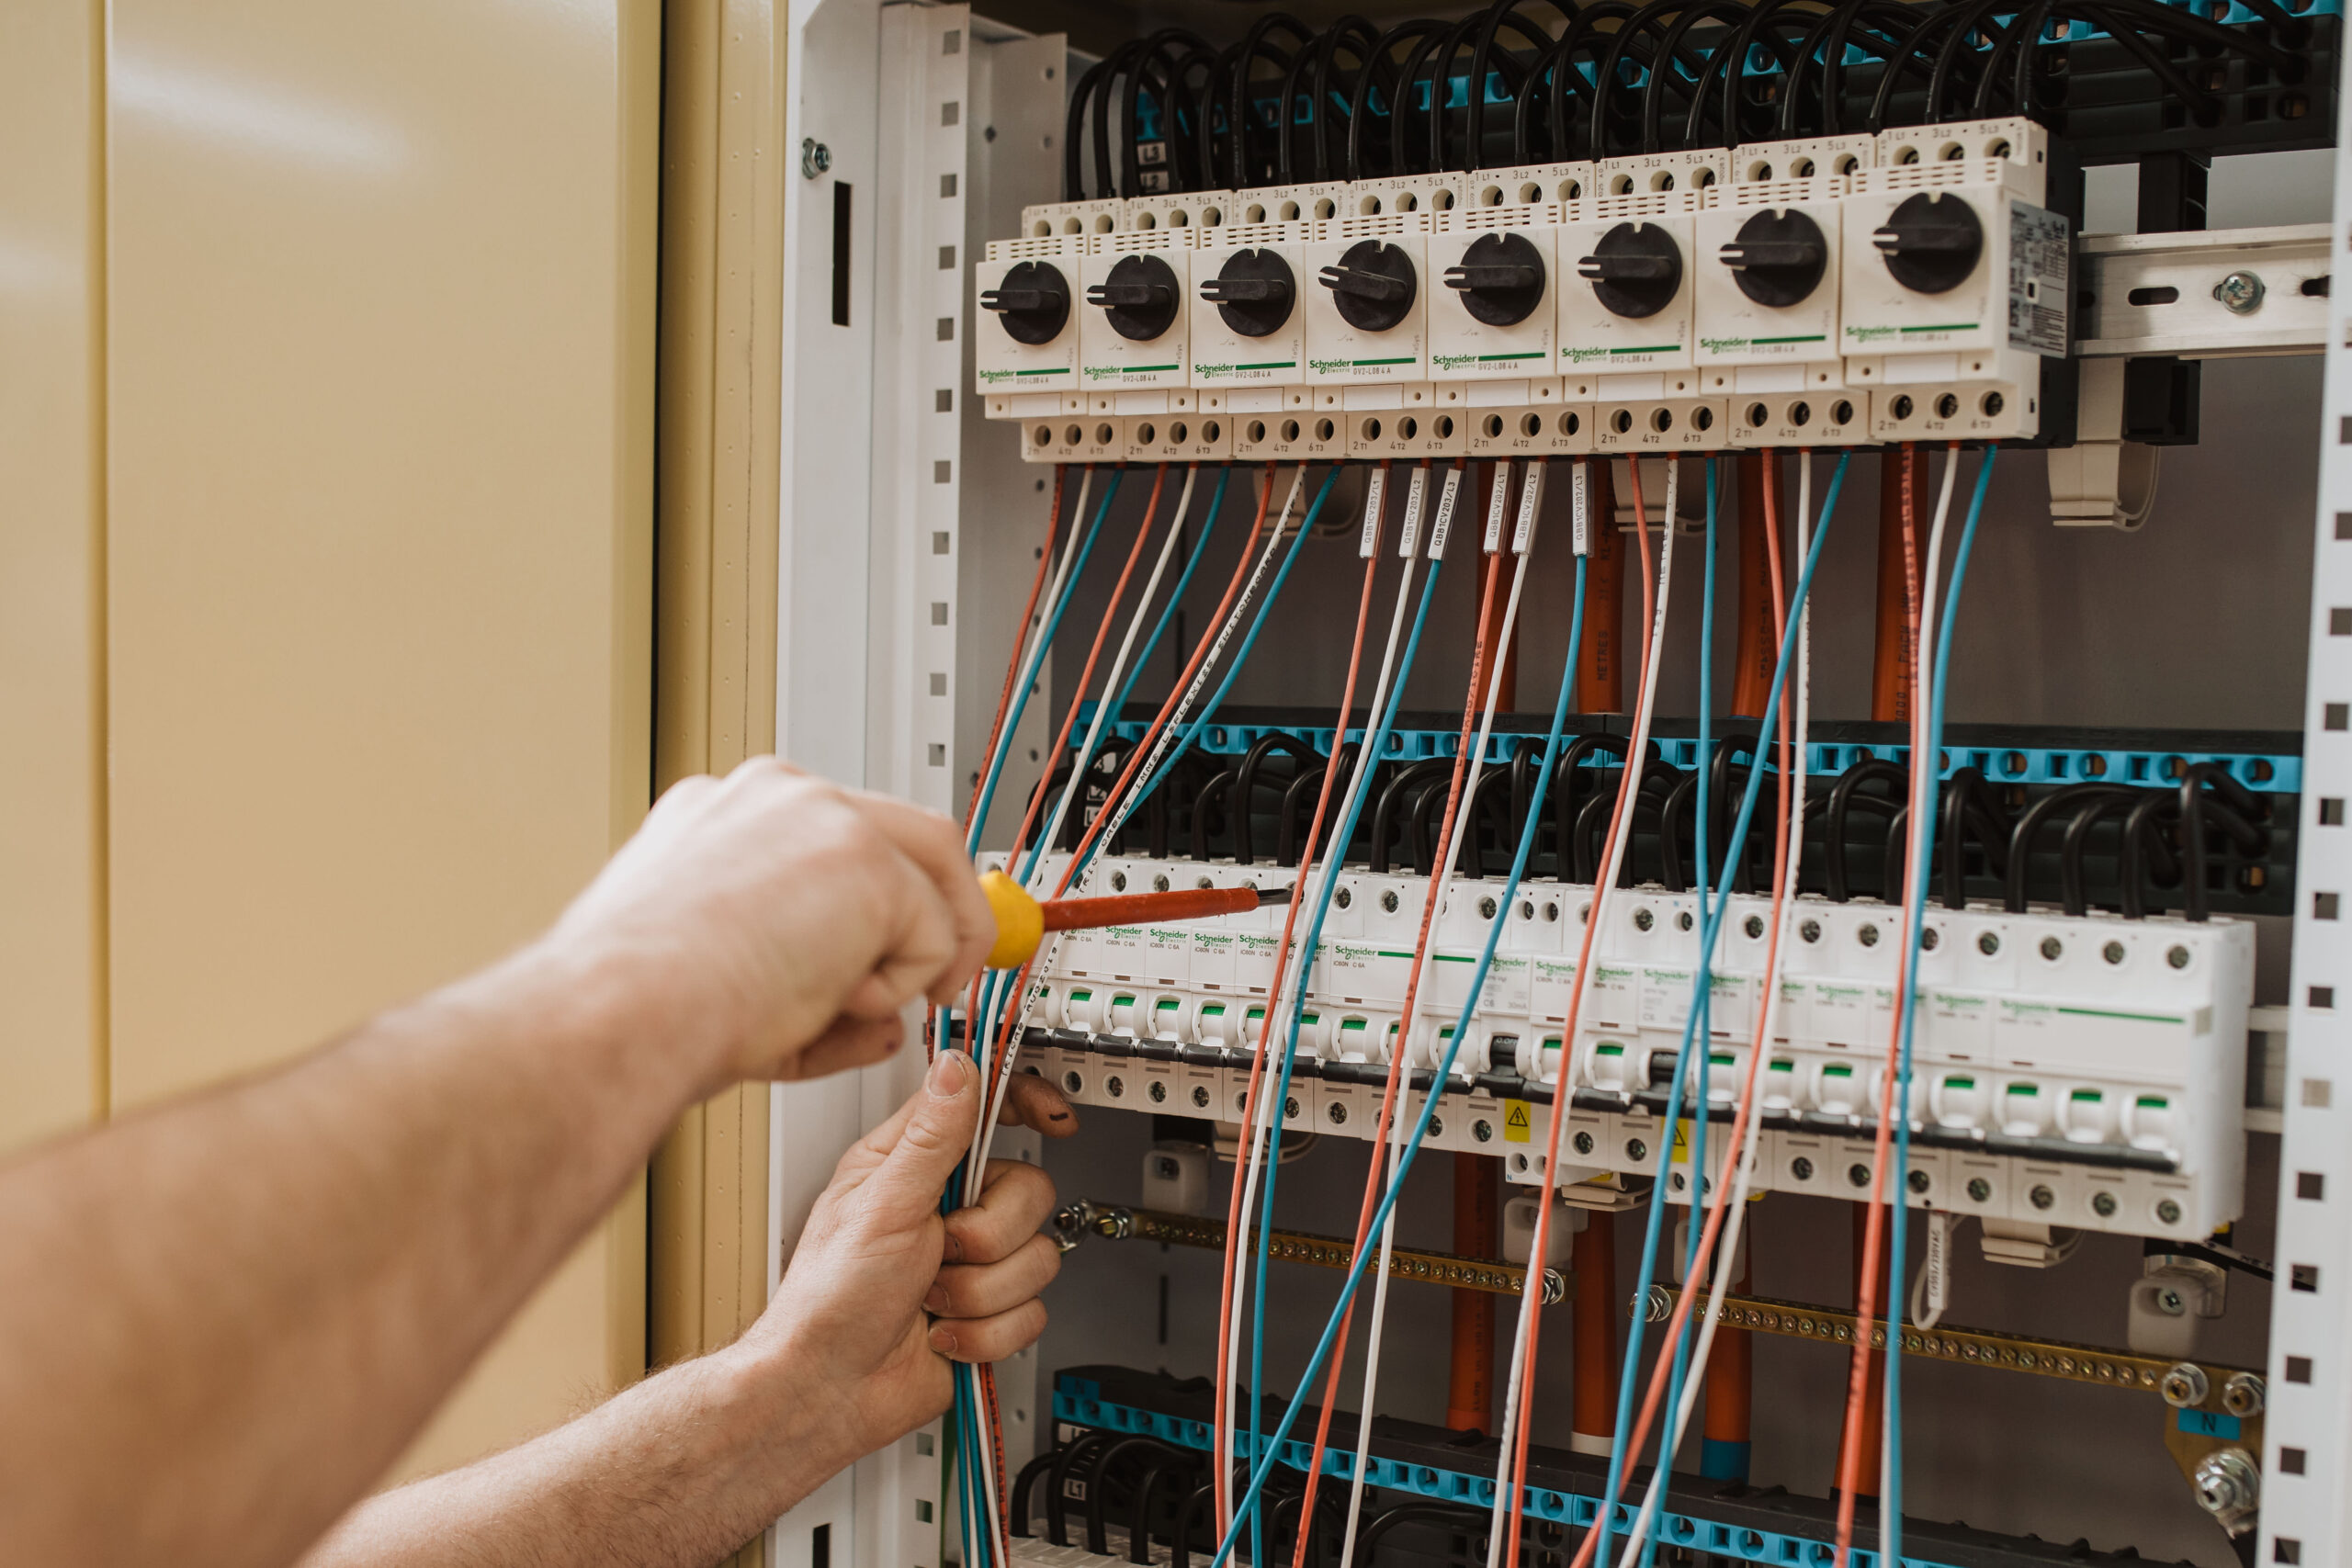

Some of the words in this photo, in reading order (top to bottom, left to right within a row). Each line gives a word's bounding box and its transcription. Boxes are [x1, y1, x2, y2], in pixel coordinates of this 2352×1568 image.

[1701, 336, 1749, 352] Schneider
[1562, 346, 1608, 361] Schneider
[1309, 358, 1351, 373] Schneider
[1432, 354, 1477, 368] Schneider
[979, 368, 1015, 381] Schneider
[1084, 366, 1122, 378] Schneider
[1194, 364, 1235, 377] Schneider
[1404, 479, 1420, 544] QBB1CV203/L2
[1489, 473, 1506, 538] QBB1CV202/L1
[1519, 473, 1538, 538] QBB1CV202/L2
[1575, 475, 1583, 541] QBB1CV202/L3
[1434, 481, 1456, 547] QBB1CV203/L3
[1105, 924, 1143, 938] Schneider
[1149, 928, 1188, 941] Schneider
[1194, 932, 1234, 945] Schneider
[1238, 934, 1279, 947] Schneider
[1335, 945, 1377, 958] Schneider
[2200, 1413, 2217, 1433] N
